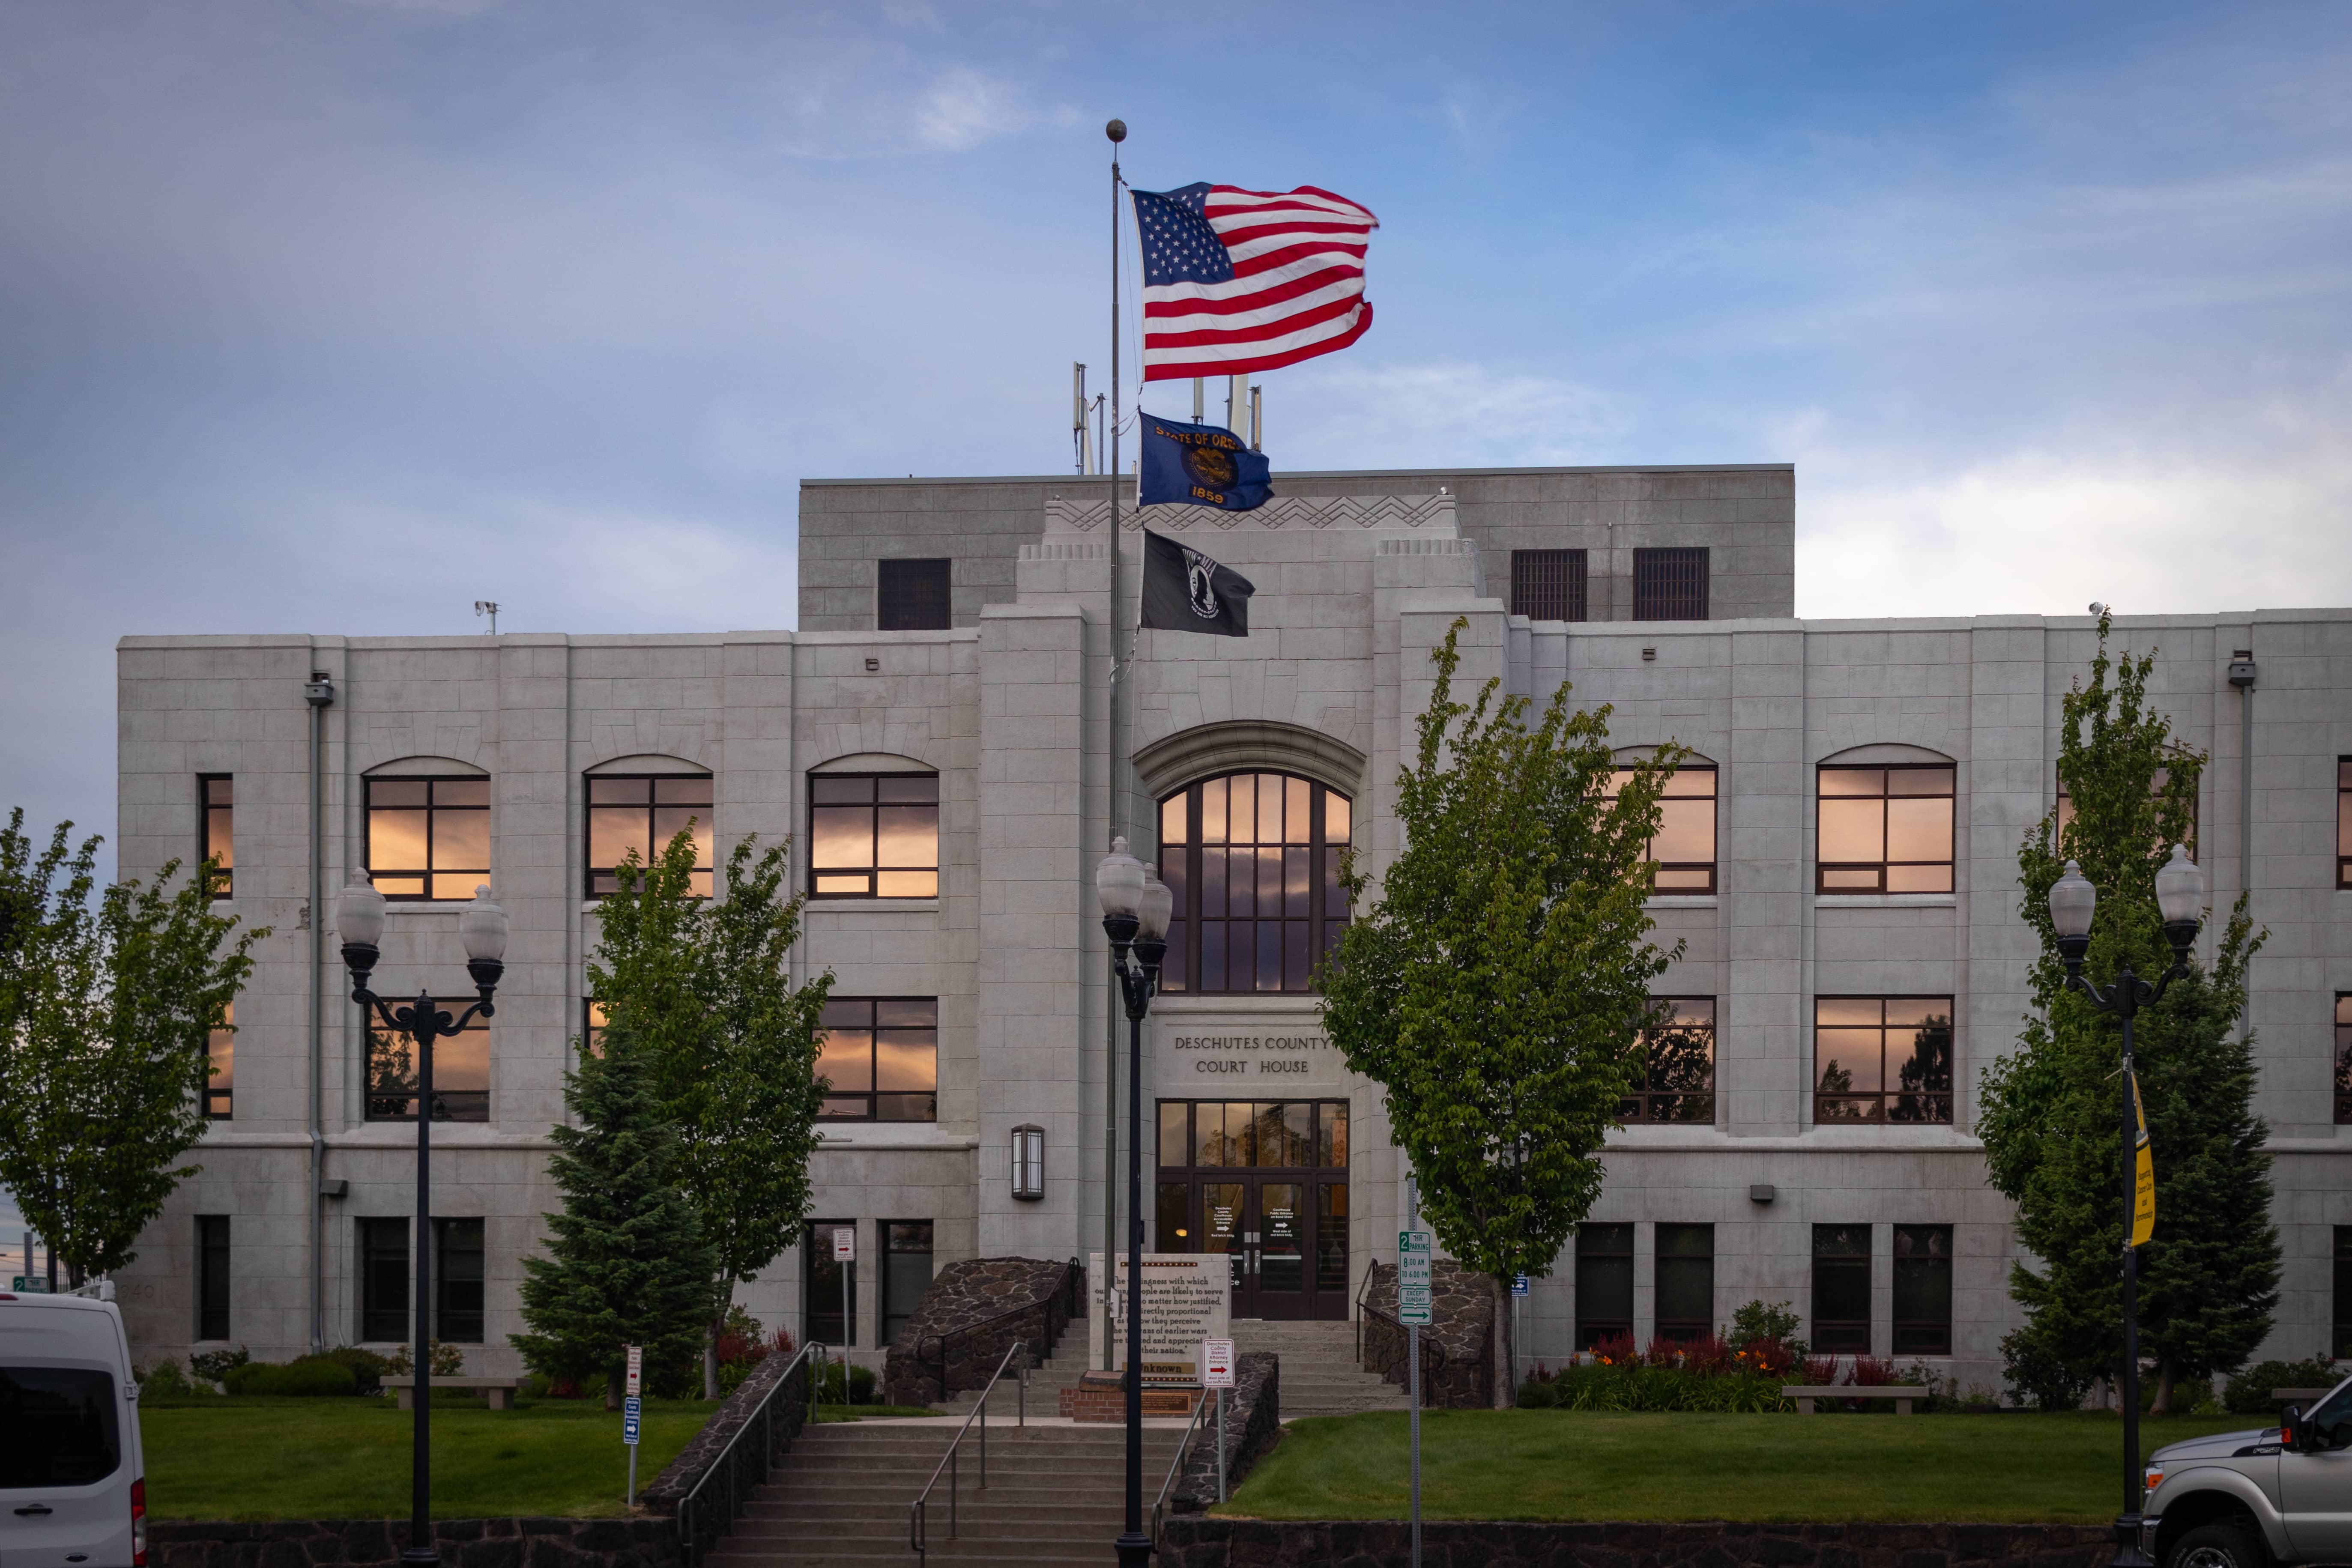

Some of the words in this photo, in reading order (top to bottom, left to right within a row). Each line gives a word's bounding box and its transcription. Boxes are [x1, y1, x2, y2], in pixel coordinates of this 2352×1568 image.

[1195, 433, 1208, 445] OF
[1192, 486, 1224, 504] 1859
[1182, 549, 1199, 576] POW
[1199, 556, 1218, 580] MIA
[1175, 1037, 1259, 1049] DESCHUTES
[1265, 1037, 1330, 1049] COUNTY
[1196, 1061, 1248, 1072] COURT
[1260, 1061, 1308, 1072] HOUSE
[1401, 1235, 1408, 1249] 2
[1404, 1257, 1416, 1268] 8:00
[1169, 1276, 1185, 1284] with
[1186, 1276, 1208, 1284] which
[1172, 1286, 1193, 1296] likely
[1174, 1296, 1188, 1304] how
[1189, 1296, 1222, 1306] justified,
[1166, 1306, 1211, 1316] proportional
[1152, 1316, 1168, 1326] they
[1170, 1318, 1201, 1326] perceive
[1156, 1326, 1163, 1334] of
[1165, 1326, 1189, 1334] earlier
[1142, 1345, 1159, 1354] their
